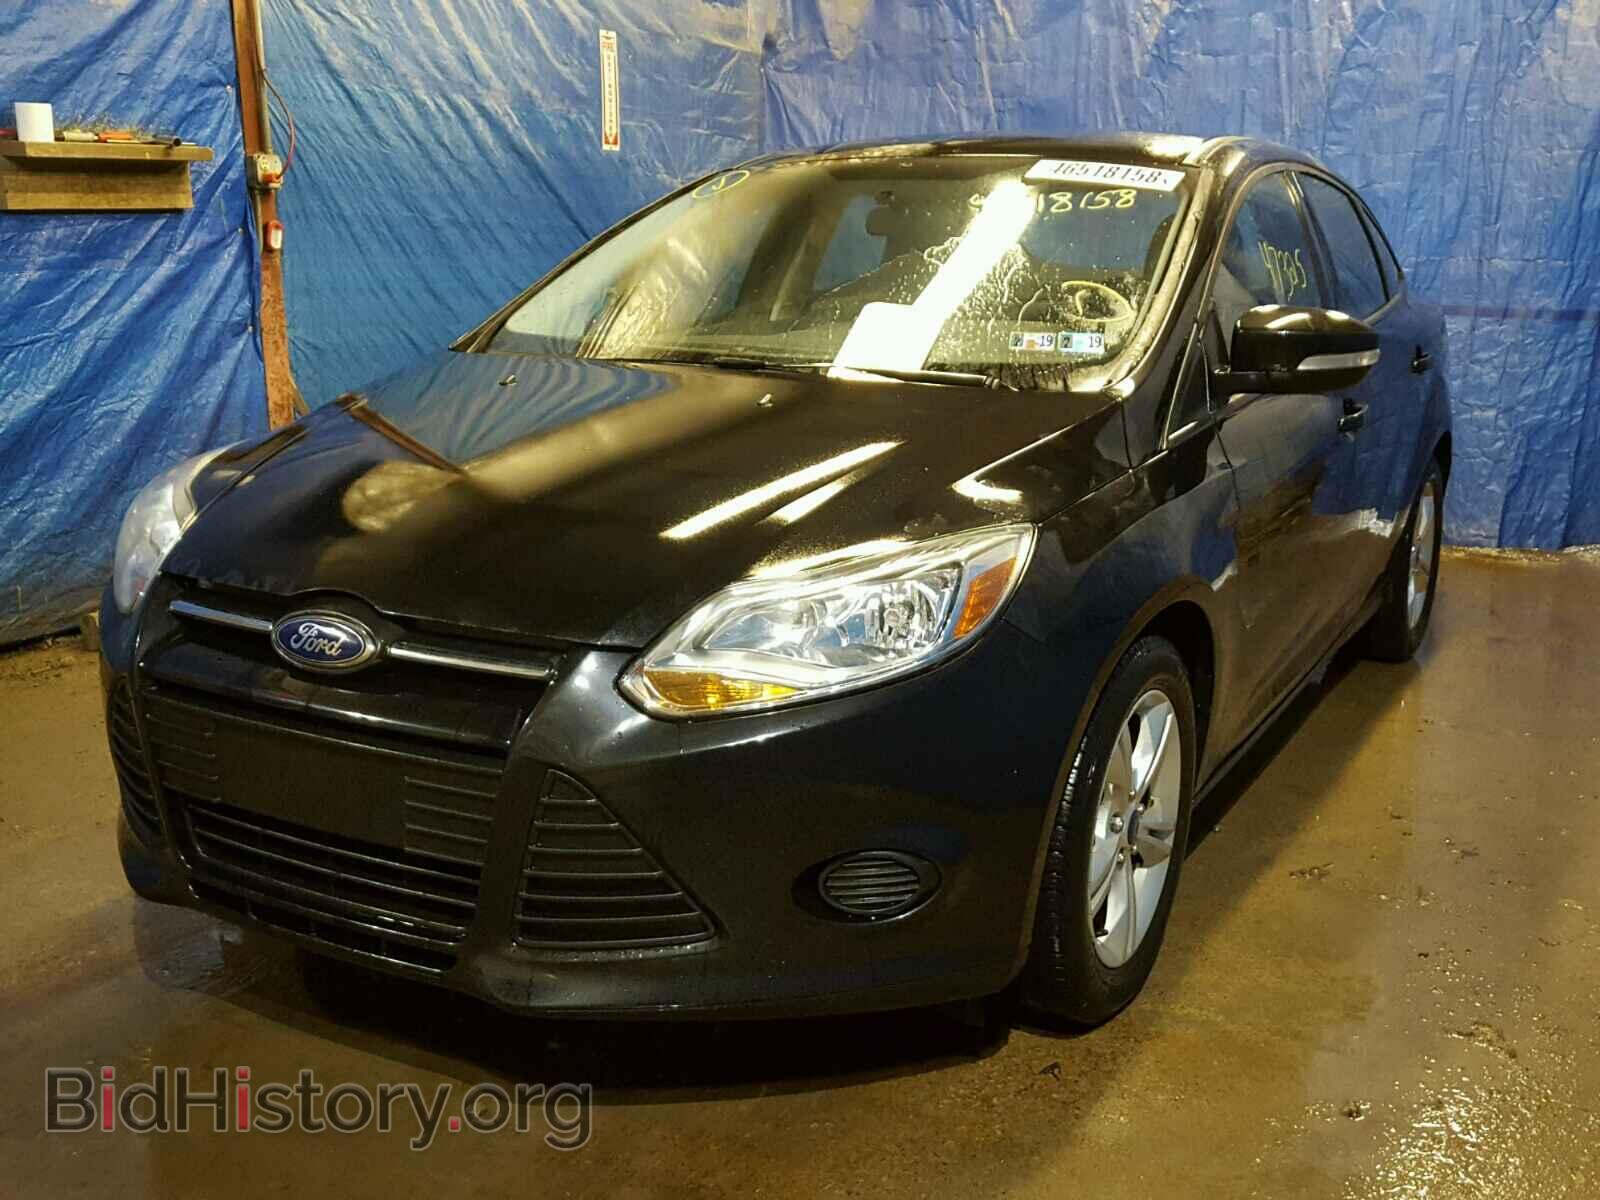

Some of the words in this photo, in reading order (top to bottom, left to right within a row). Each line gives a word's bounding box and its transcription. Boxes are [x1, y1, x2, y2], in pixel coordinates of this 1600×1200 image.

[1040, 335, 1053, 347] 19
[1089, 336, 1101, 348] 19
[290, 622, 346, 657] Ford
